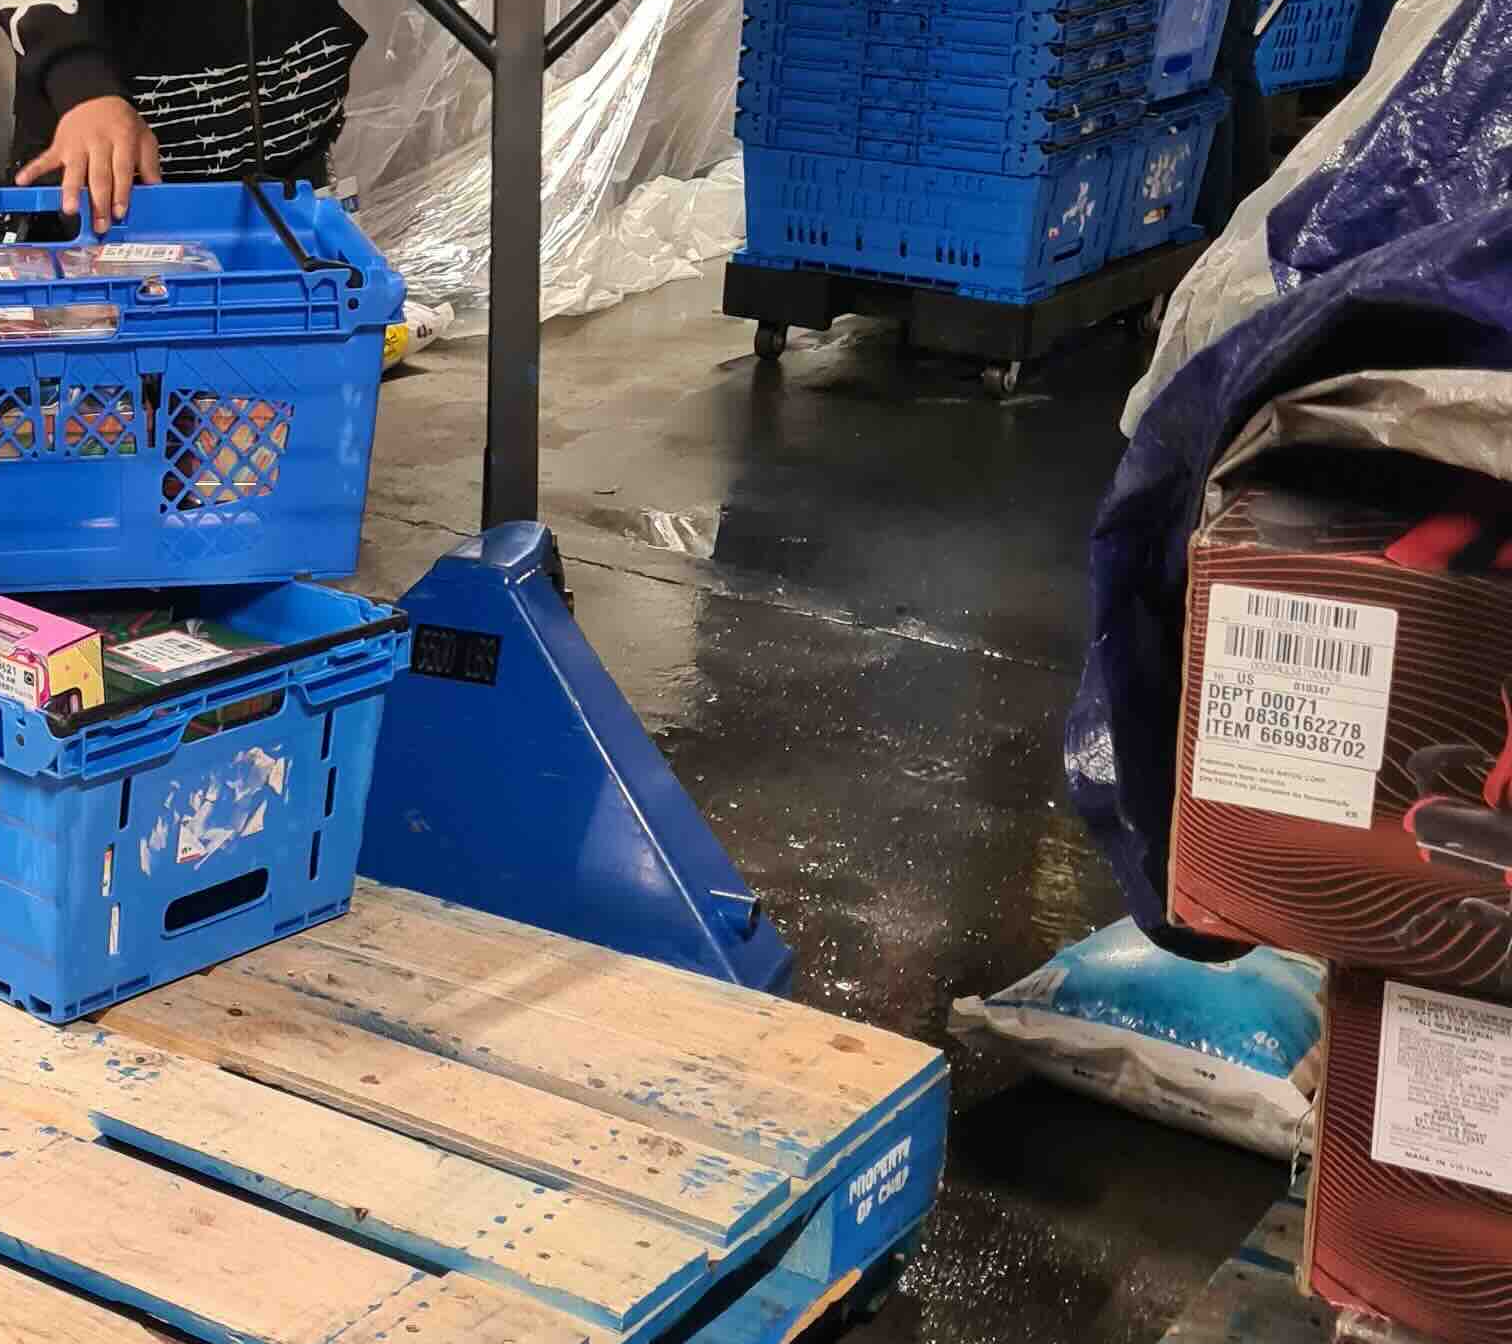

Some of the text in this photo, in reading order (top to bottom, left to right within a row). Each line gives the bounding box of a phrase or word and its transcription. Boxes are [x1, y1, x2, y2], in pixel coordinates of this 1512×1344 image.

[1208, 683, 1318, 716] DEPT 00071
[1205, 718, 1367, 760] ITEM 669938702
[1207, 700, 1362, 740] PO 0836162278
